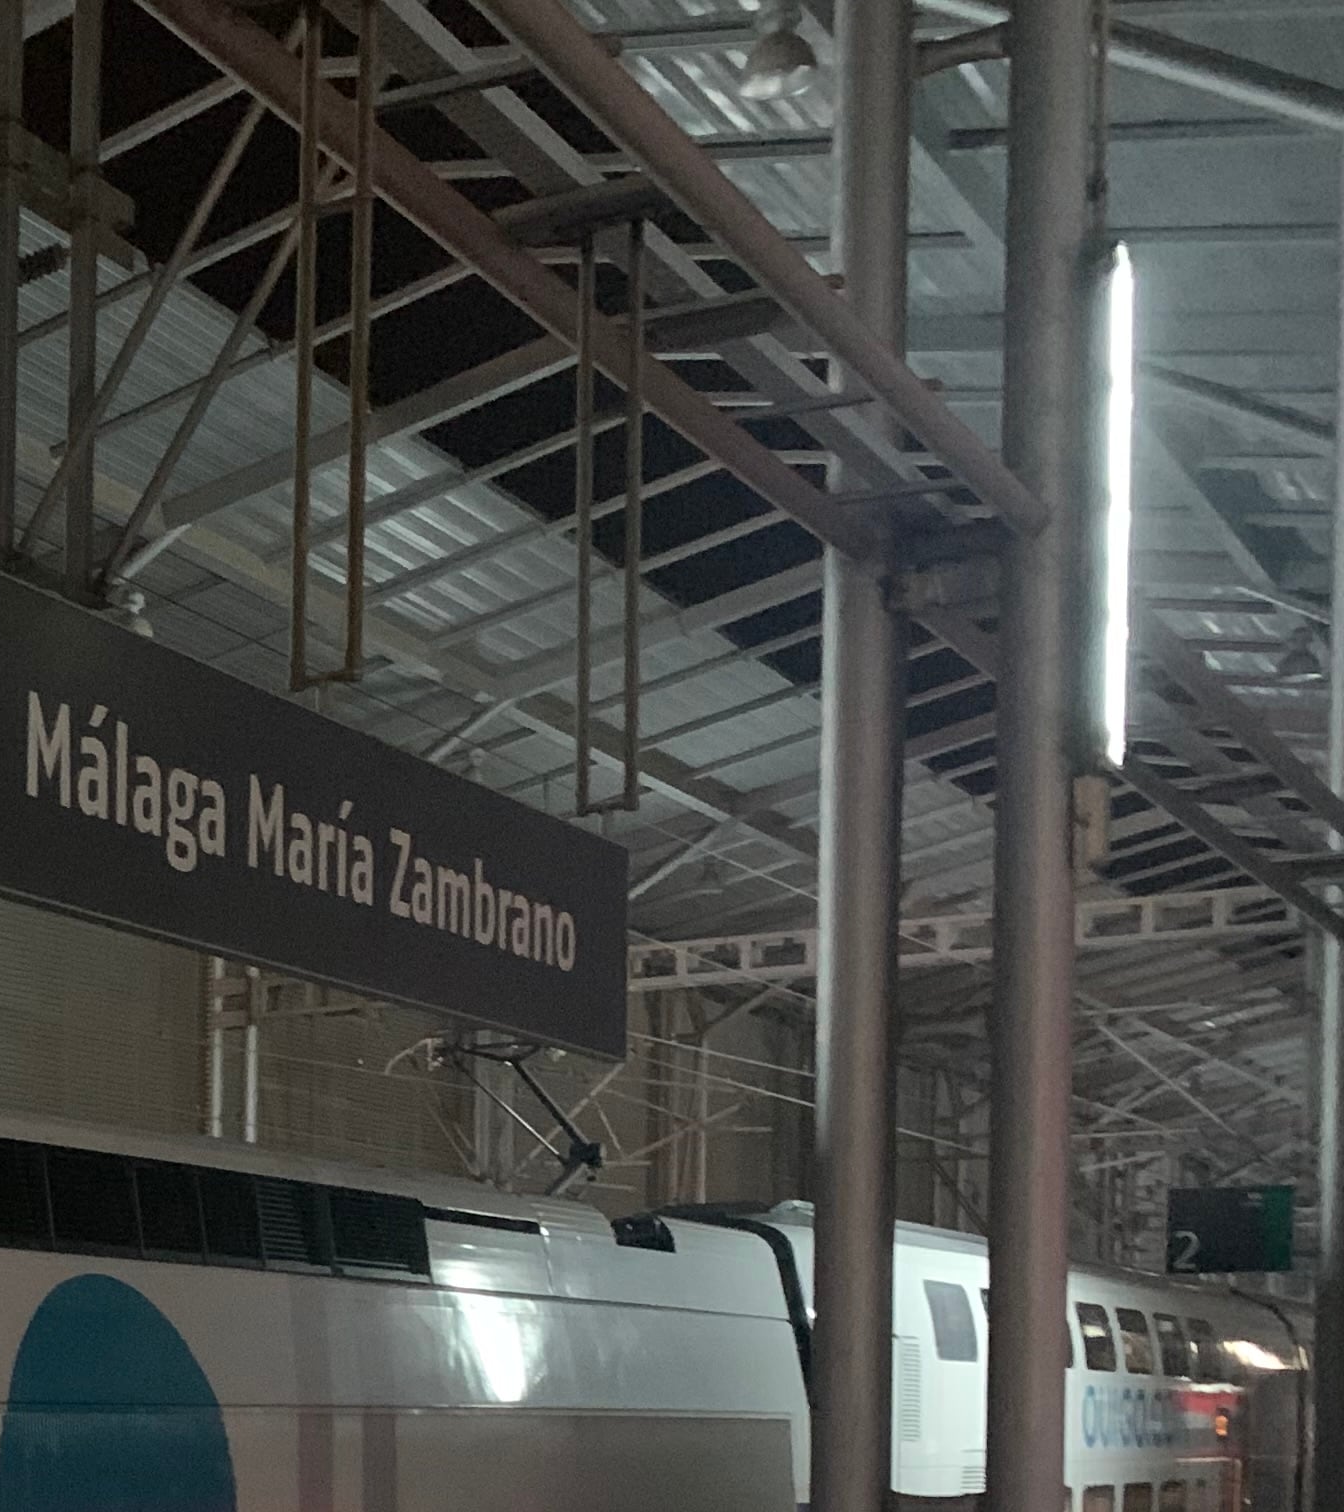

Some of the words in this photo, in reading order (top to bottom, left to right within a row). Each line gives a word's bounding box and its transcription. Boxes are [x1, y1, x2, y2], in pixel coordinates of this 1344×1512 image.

[26, 690, 226, 873] Málaga
[247, 773, 375, 907] María
[390, 826, 576, 973] Zambrano
[1172, 1230, 1201, 1270] 2
